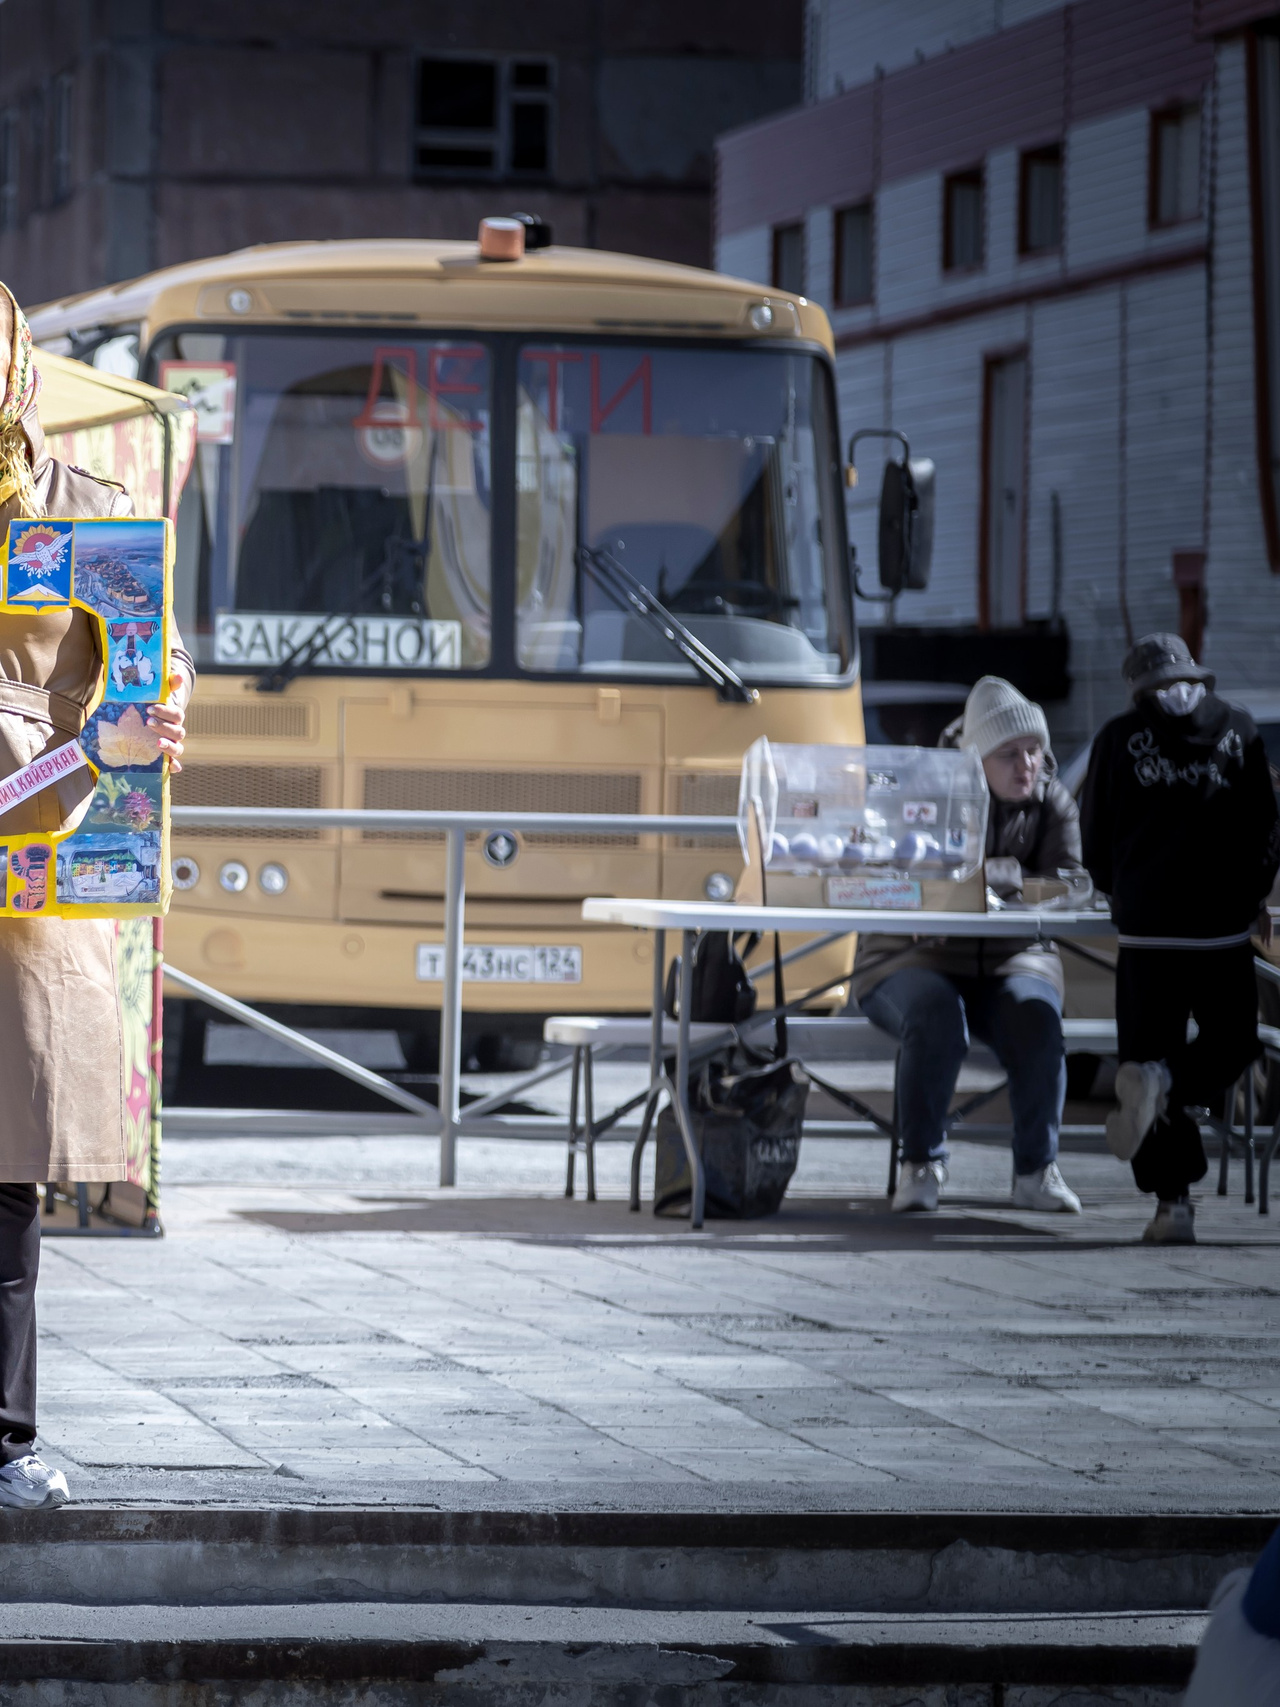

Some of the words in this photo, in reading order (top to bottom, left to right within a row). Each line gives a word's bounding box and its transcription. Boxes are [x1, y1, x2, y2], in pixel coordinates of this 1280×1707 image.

[353, 346, 651, 436] ДЕТИ
[221, 617, 456, 666] ЗАКАЗНОЙ
[15, 745, 80, 793] КАЙЕРКАН
[426, 948, 531, 979] Т43НС
